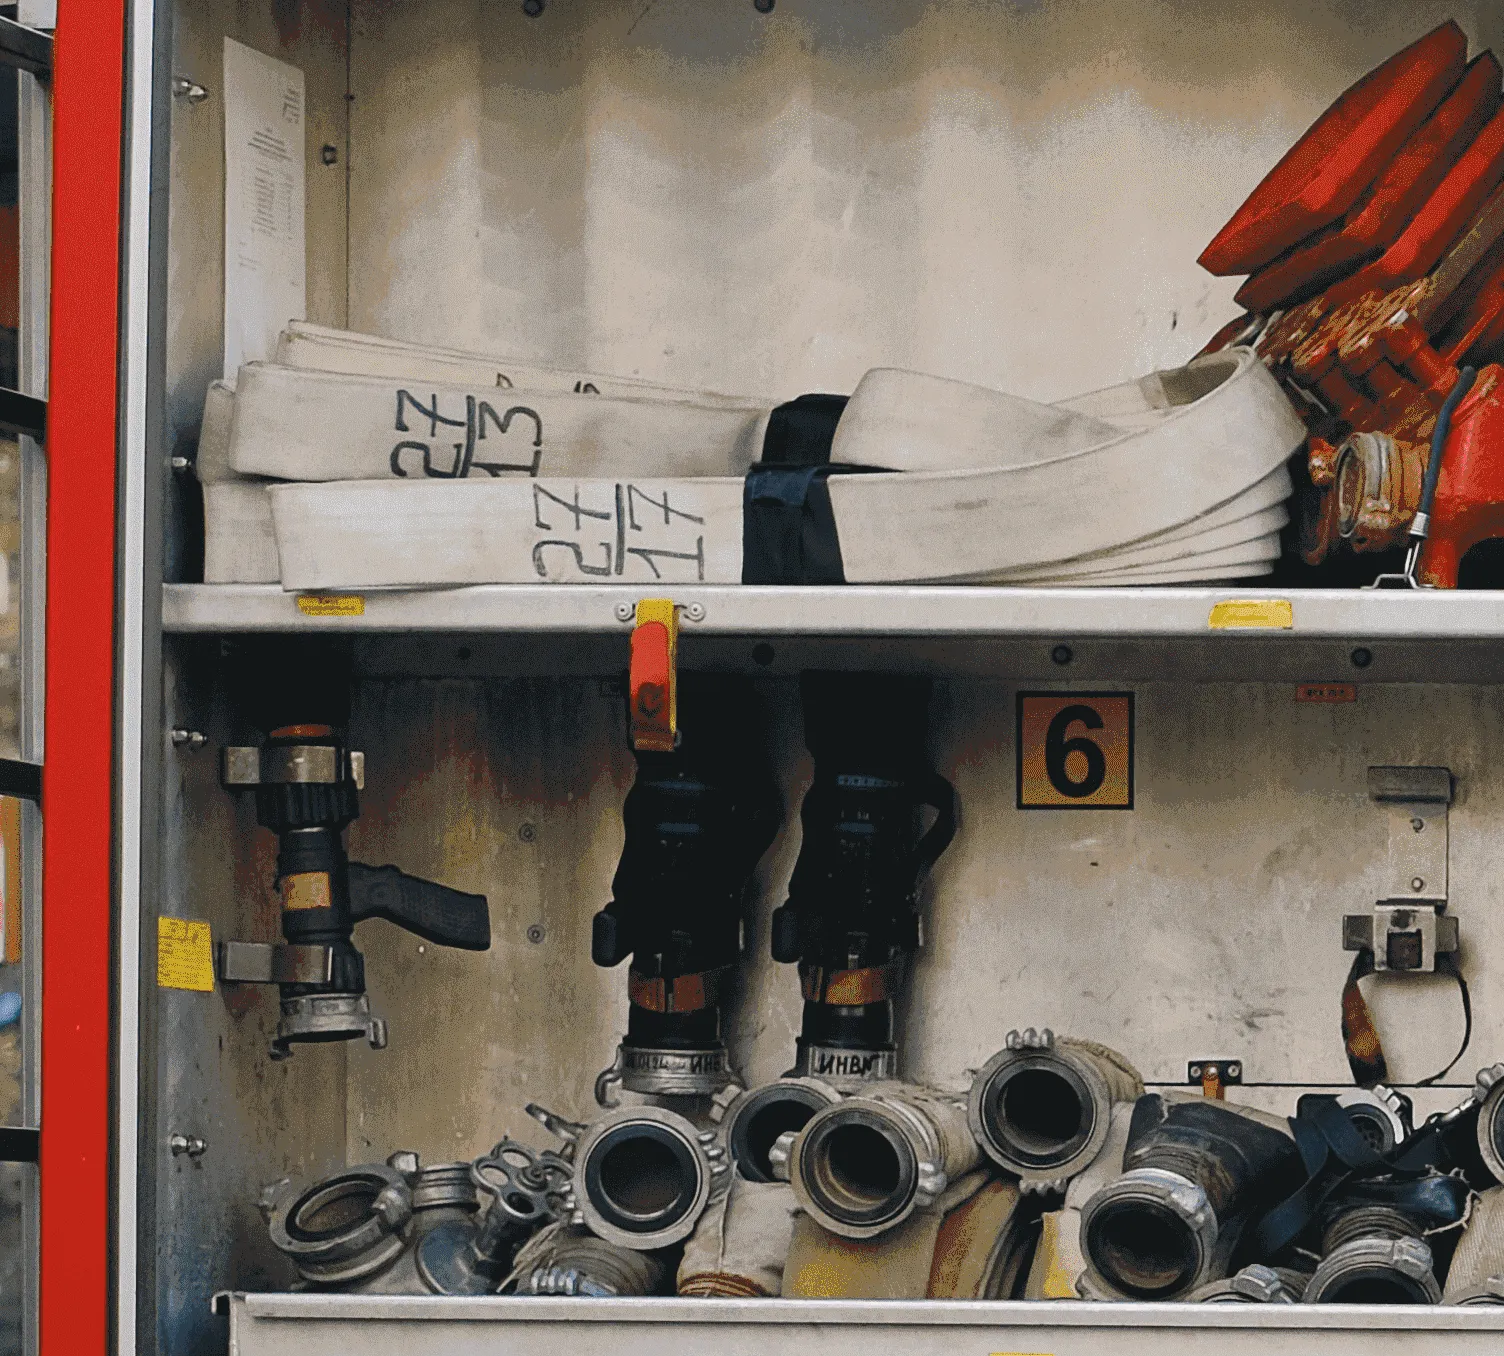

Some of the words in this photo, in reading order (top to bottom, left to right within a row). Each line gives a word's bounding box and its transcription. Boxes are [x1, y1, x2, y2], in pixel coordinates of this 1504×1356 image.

[390, 388, 467, 479] 27
[532, 483, 613, 578] 27
[626, 484, 706, 581] 17
[1045, 704, 1106, 798] 6
